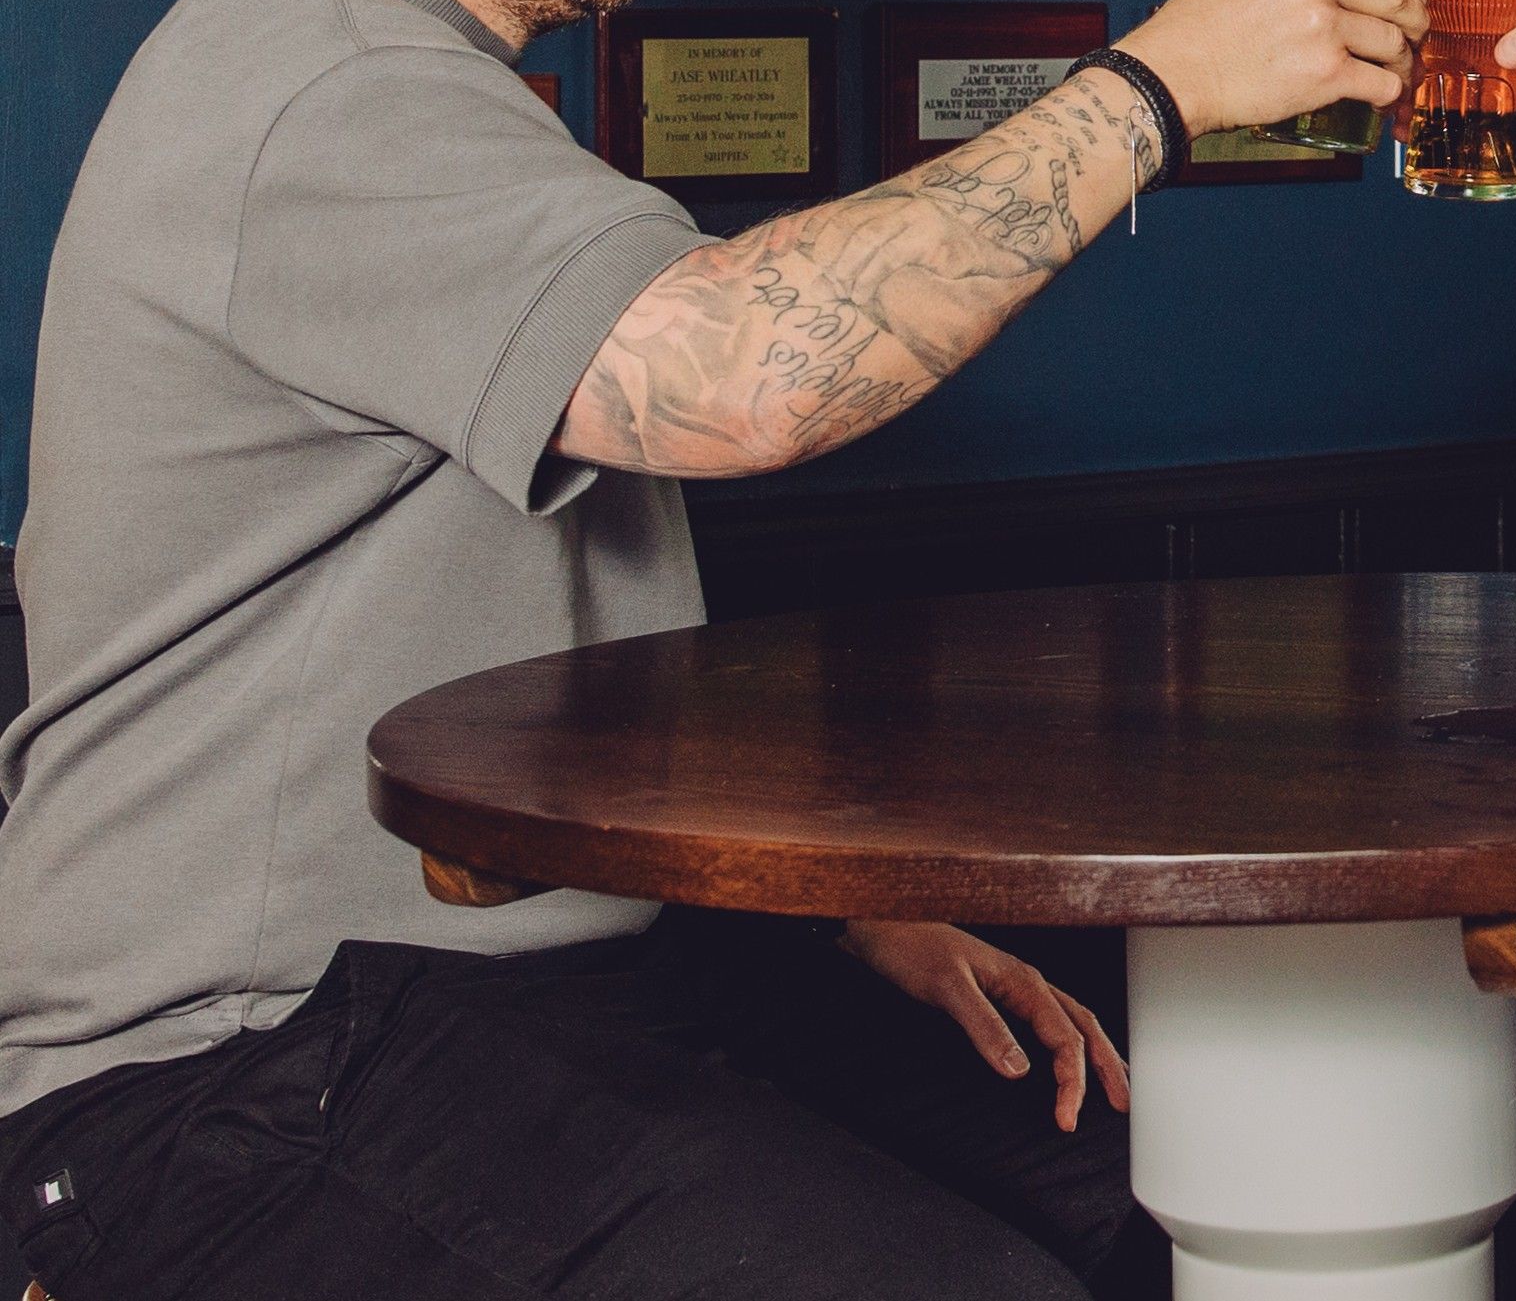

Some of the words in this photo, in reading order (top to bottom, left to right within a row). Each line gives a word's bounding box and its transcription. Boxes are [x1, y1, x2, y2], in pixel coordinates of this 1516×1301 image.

[688, 48, 699, 59] IN
[703, 48, 745, 59] MEMORY
[750, 48, 763, 58] OF
[968, 64, 981, 74] IN
[982, 64, 1025, 74] MEMORY
[1027, 64, 1040, 74] OF
[671, 70, 704, 83] JASE
[708, 68, 781, 83] WHEATLEY
[960, 76, 991, 86] JAMIE
[993, 75, 1046, 86] WHEATLEY
[924, 100, 964, 110] ALWAYS
[965, 99, 997, 109] MISSED
[999, 99, 1028, 109] NEVER
[724, 112, 750, 121] Never
[934, 111, 961, 121] FROM
[964, 111, 984, 121] ALL
[665, 132, 690, 142] From
[693, 131, 708, 141] All
[711, 130, 734, 140] Your
[738, 130, 771, 139] Friends
